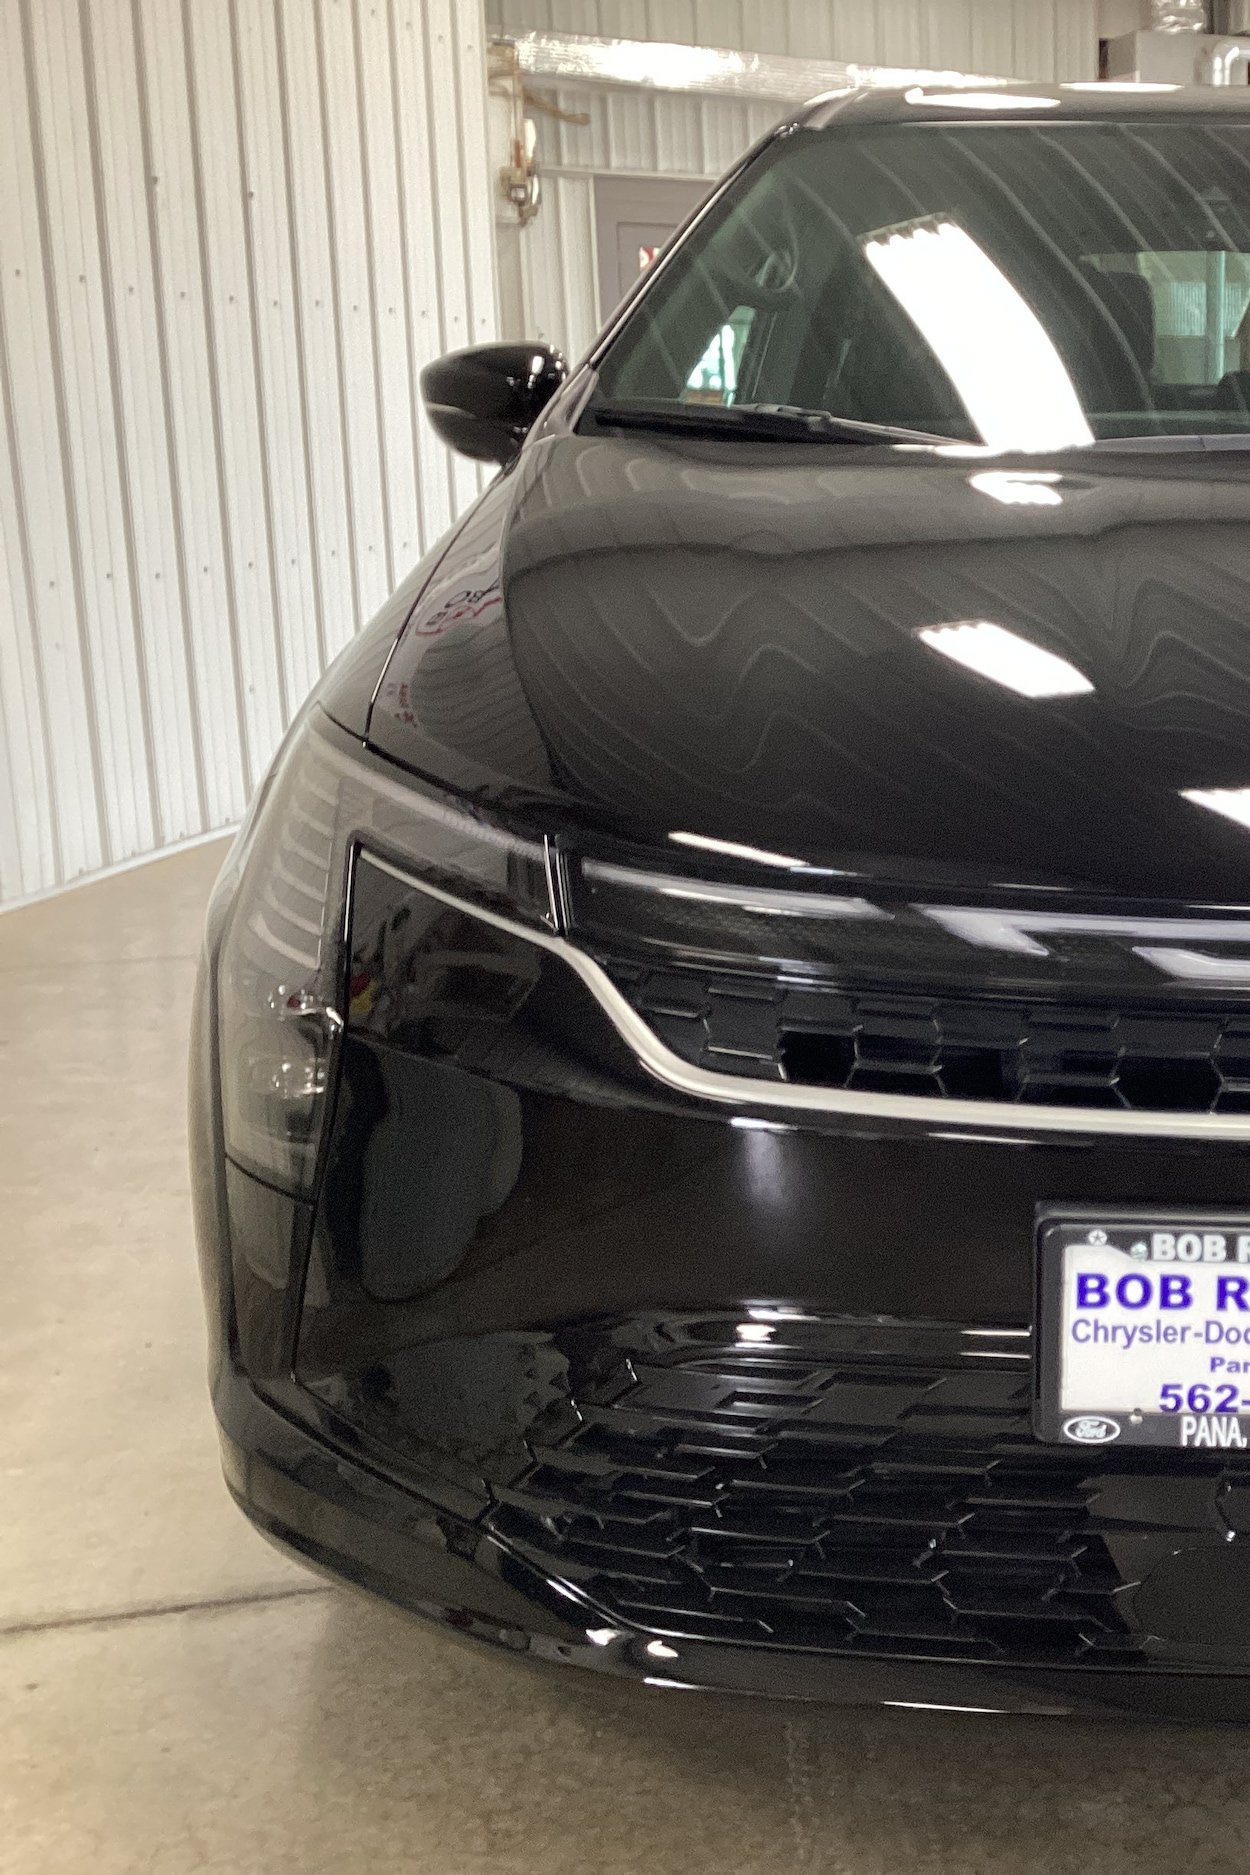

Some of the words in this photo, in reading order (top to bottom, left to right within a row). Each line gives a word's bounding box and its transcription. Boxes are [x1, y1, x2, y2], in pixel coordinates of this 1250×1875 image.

[1151, 1232, 1227, 1262] BOB
[1075, 1272, 1194, 1311] BOB
[1180, 1416, 1248, 1448] PANA,
